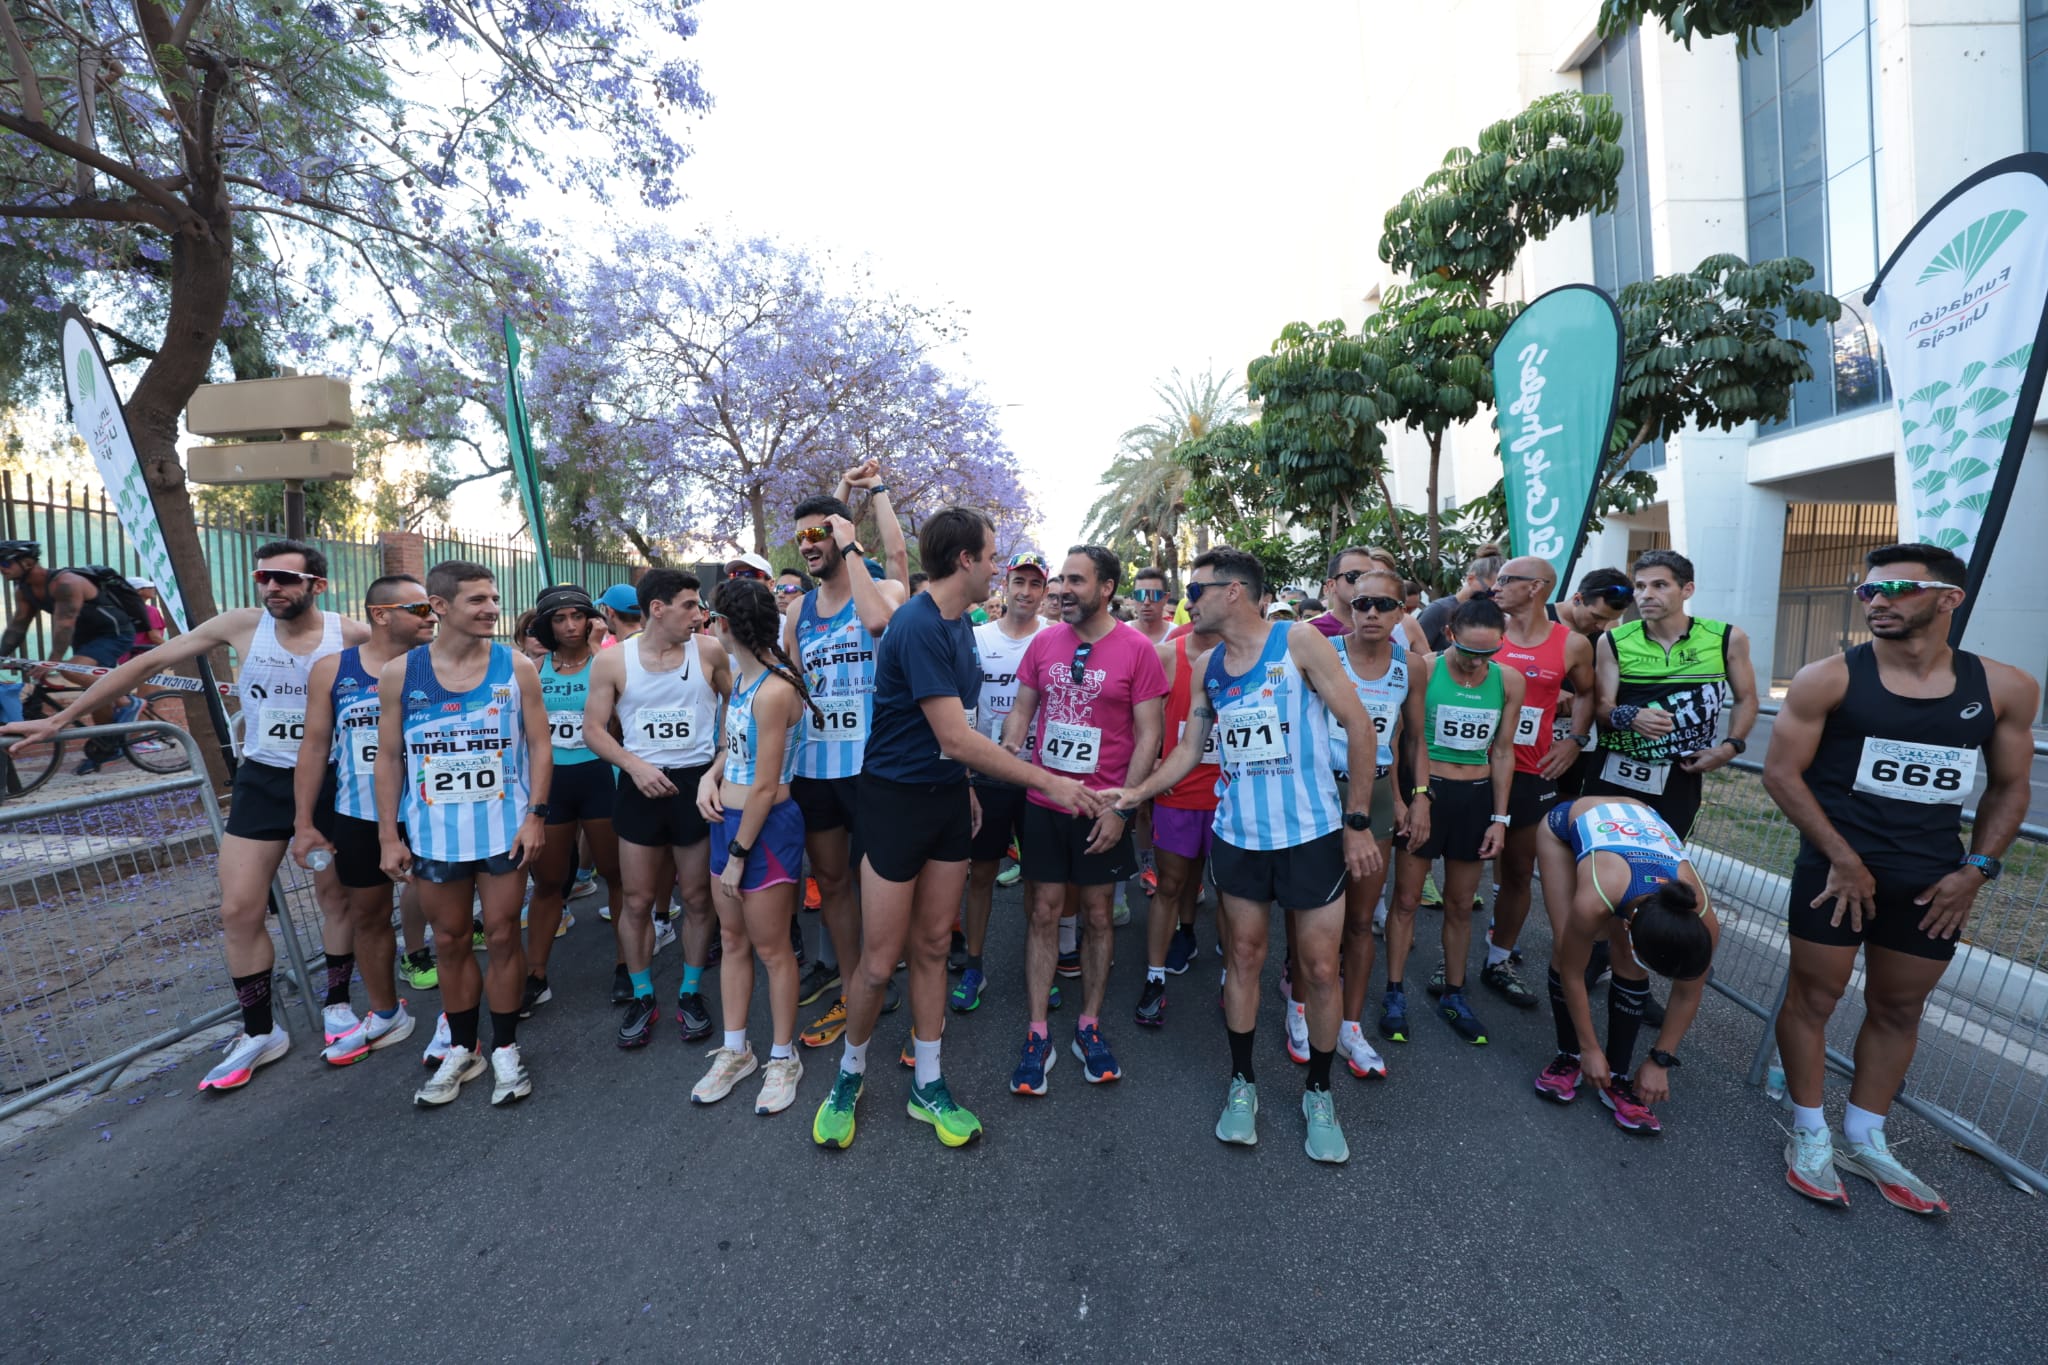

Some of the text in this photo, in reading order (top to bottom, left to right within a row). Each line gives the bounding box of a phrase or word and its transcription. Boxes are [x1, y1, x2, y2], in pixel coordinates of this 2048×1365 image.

[161, 676, 199, 690] POLICIA
[542, 681, 586, 696] erja
[424, 728, 499, 738] ATLETISMO
[642, 722, 690, 739] 136
[1226, 725, 1273, 748] 471
[1443, 720, 1490, 739] 586
[1519, 720, 1533, 735] 9
[1046, 738, 1092, 761] 472
[434, 769, 496, 792] 210
[1618, 761, 1651, 782] 59
[1871, 759, 1962, 791] 668
